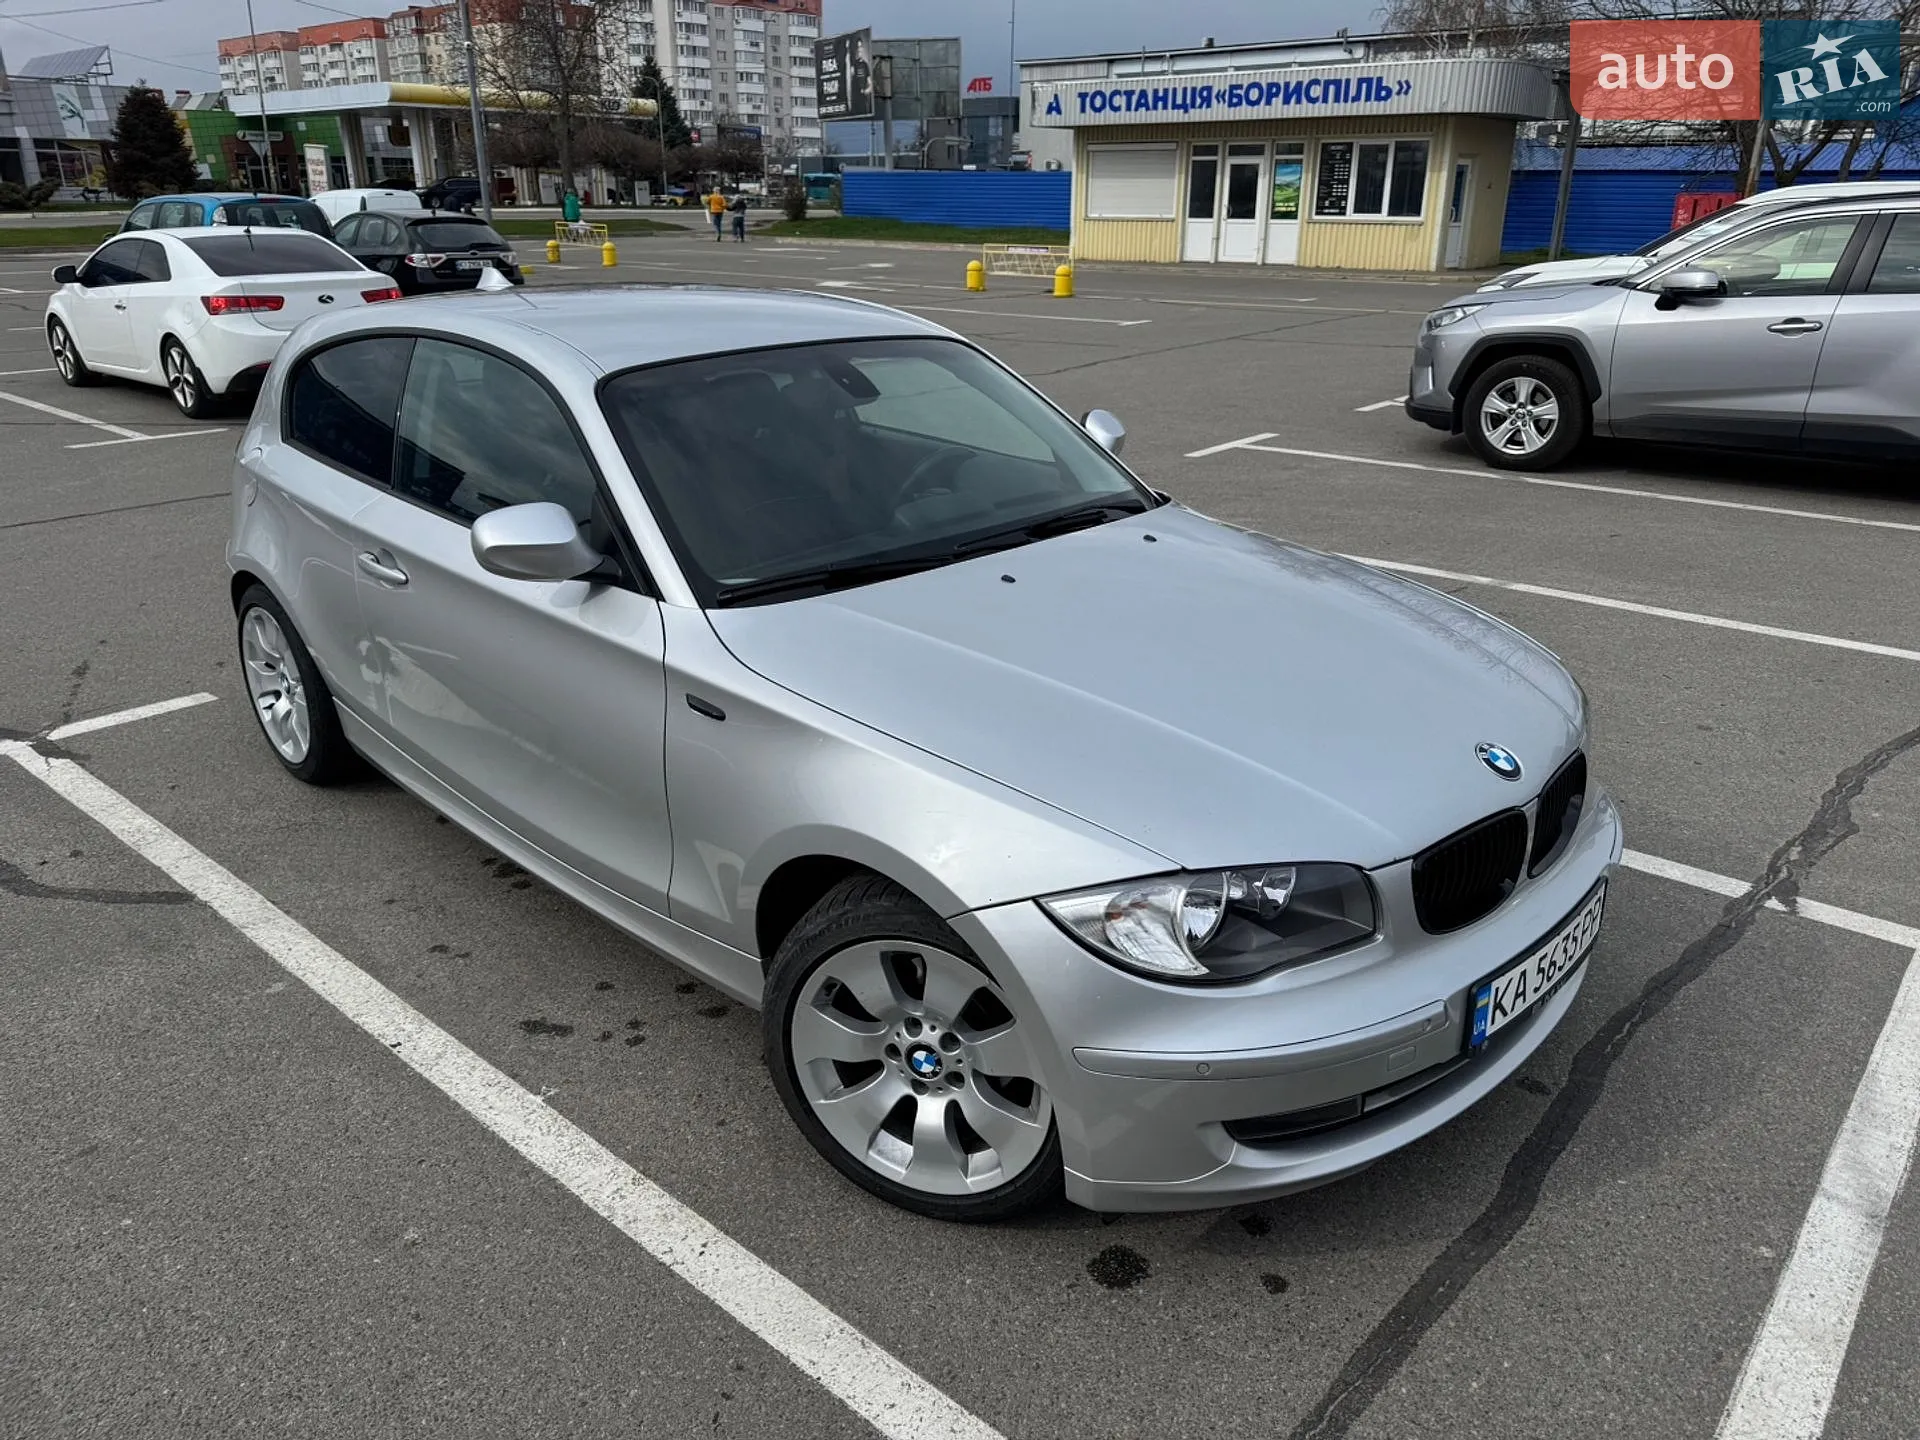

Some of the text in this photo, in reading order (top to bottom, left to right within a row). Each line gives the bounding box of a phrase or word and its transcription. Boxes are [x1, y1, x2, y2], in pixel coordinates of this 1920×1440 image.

[967, 77, 993, 93] АТБ
[1045, 76, 1413, 116] А ТОСТАНЦІЯ «БОРИСПІЛЬ»
[1490, 967, 1528, 1027] KA
[1533, 921, 1582, 995] 5635
[1473, 1018, 1486, 1036] UA
